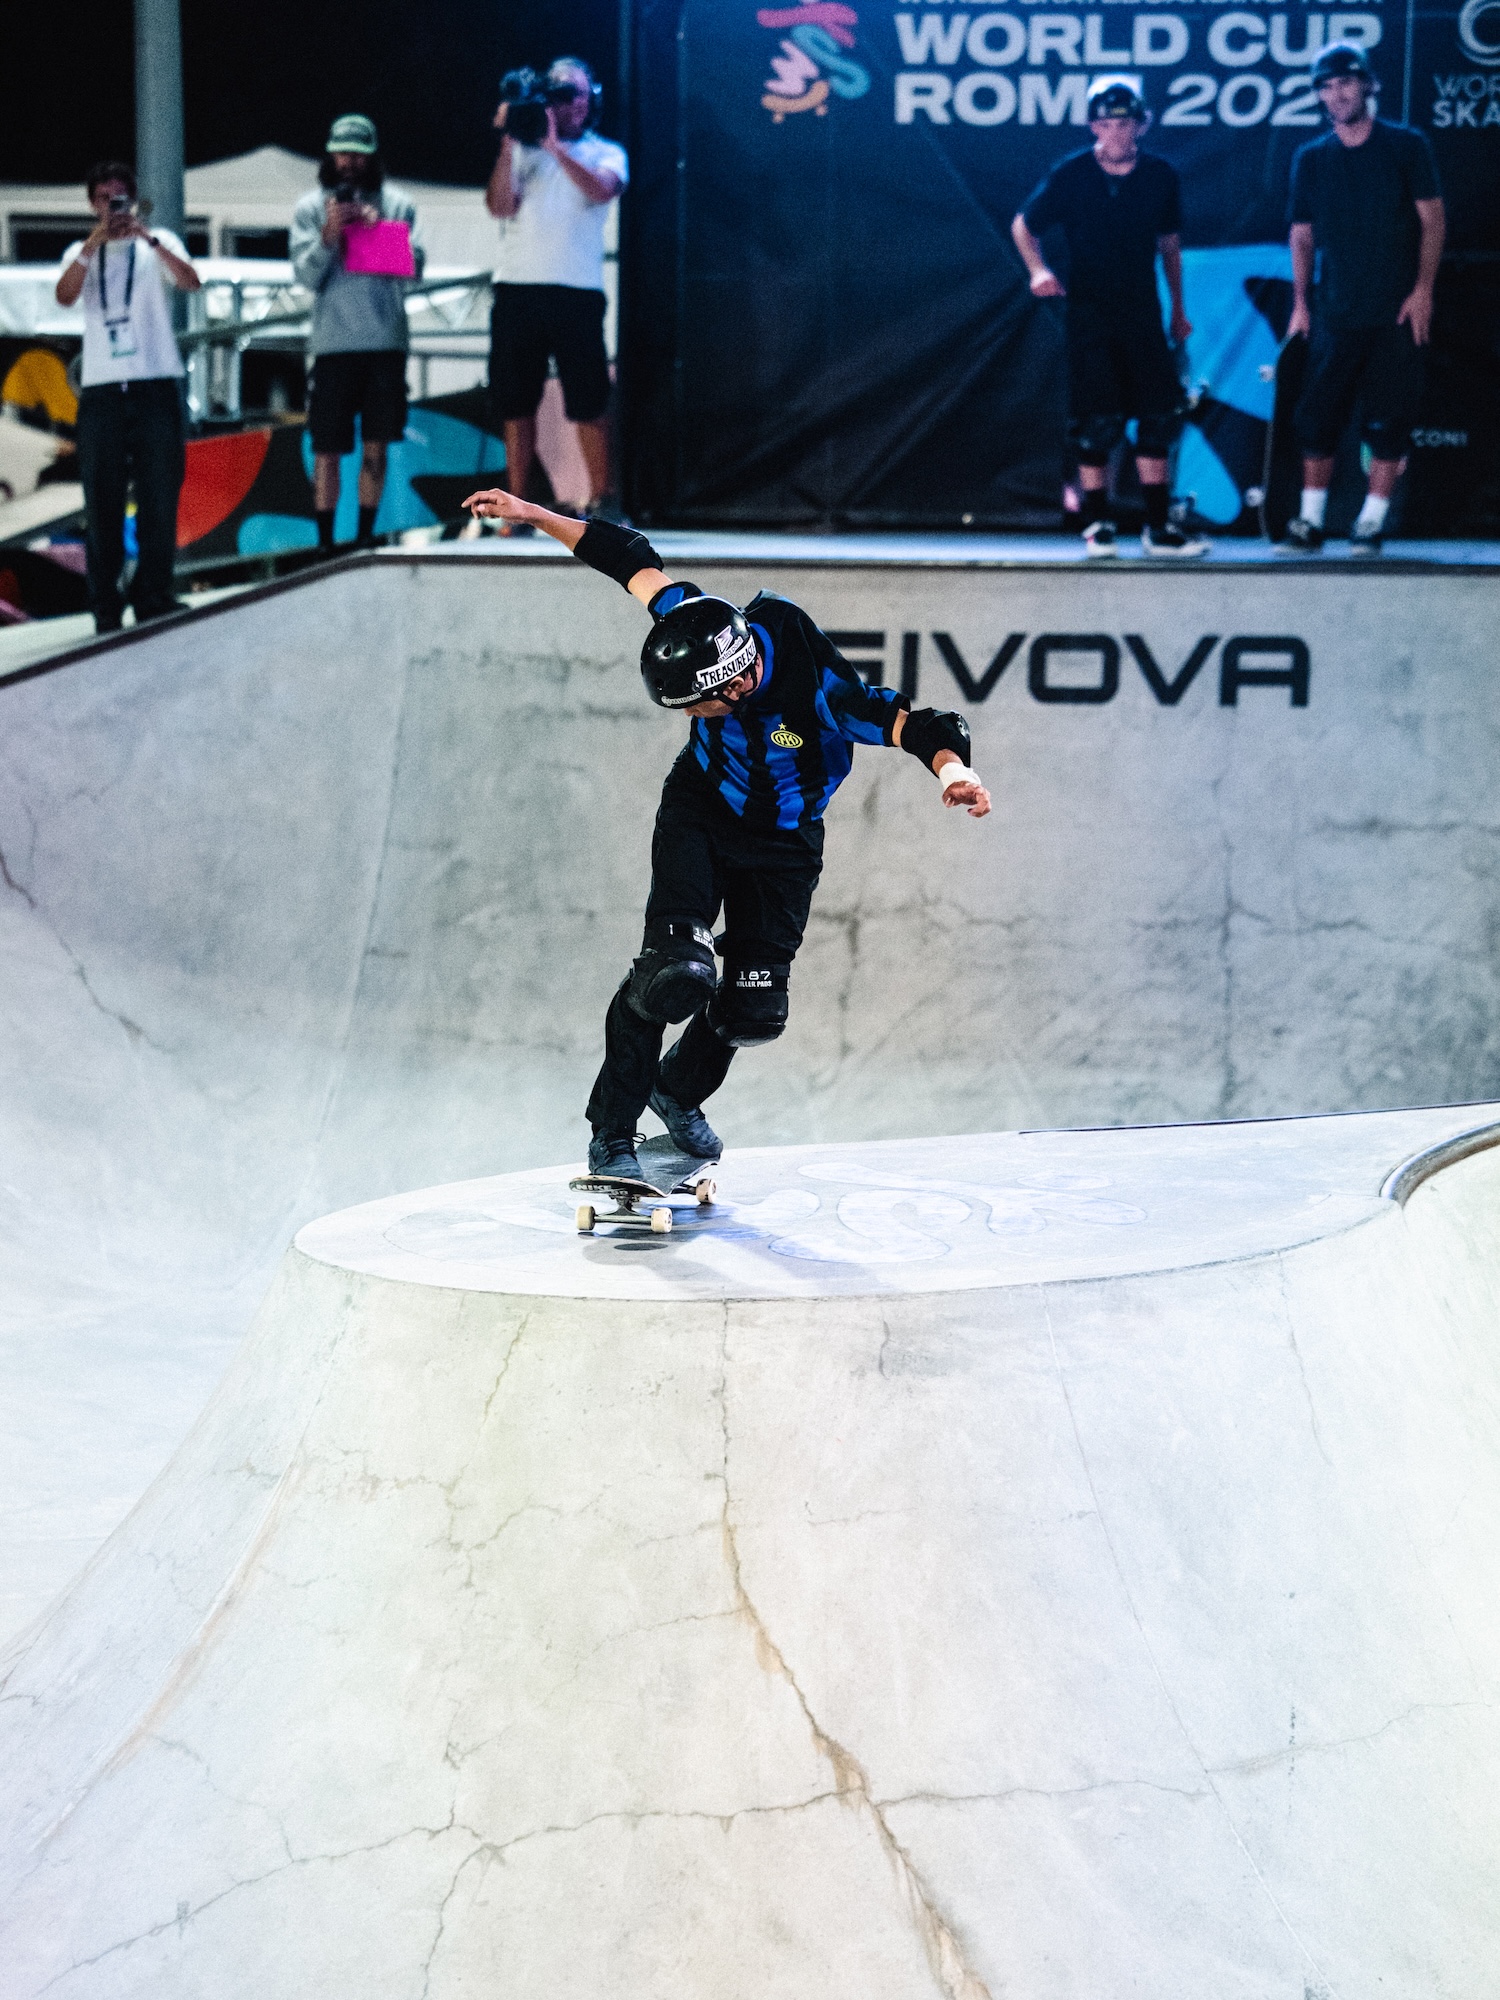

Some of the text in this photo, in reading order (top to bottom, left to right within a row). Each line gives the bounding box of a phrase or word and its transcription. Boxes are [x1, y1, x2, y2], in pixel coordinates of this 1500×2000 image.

[894, 12, 1382, 67] WORLD CUP
[894, 72, 1378, 126] ROM 202
[1433, 101, 1500, 127] SKA
[1410, 428, 1468, 447] CONI
[700, 652, 747, 687] TREASURE
[739, 971, 770, 980] 187
